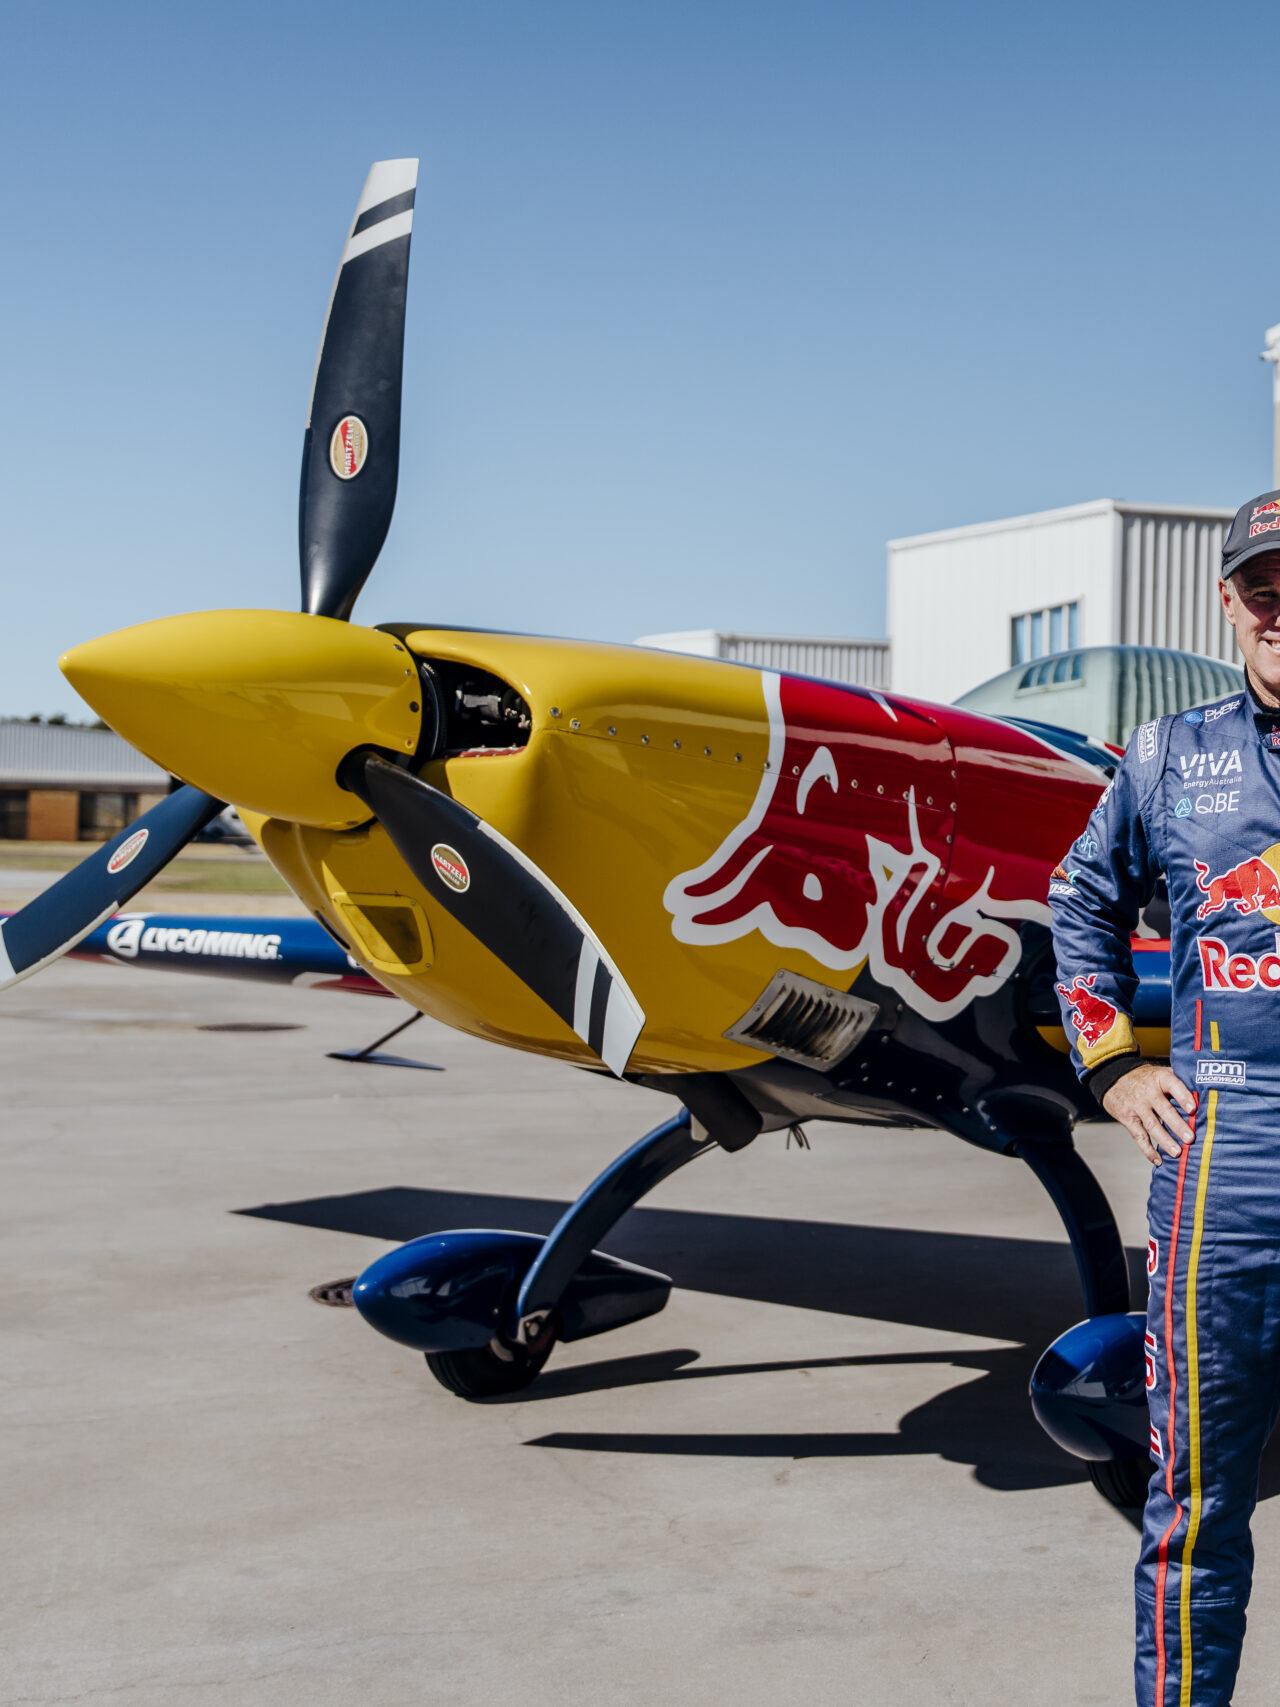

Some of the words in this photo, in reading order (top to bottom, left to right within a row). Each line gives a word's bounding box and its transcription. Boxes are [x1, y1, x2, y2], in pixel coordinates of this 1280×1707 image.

[344, 421, 354, 474] HARTZELL
[1146, 721, 1156, 757] rpm
[1180, 749, 1243, 779] VIVA
[1195, 791, 1240, 814] QBE
[434, 852, 466, 884] HARTZELL
[141, 927, 281, 960] LYCOMING
[1197, 1076, 1243, 1084] RACEWEAR
[1200, 1063, 1242, 1075] rpm
